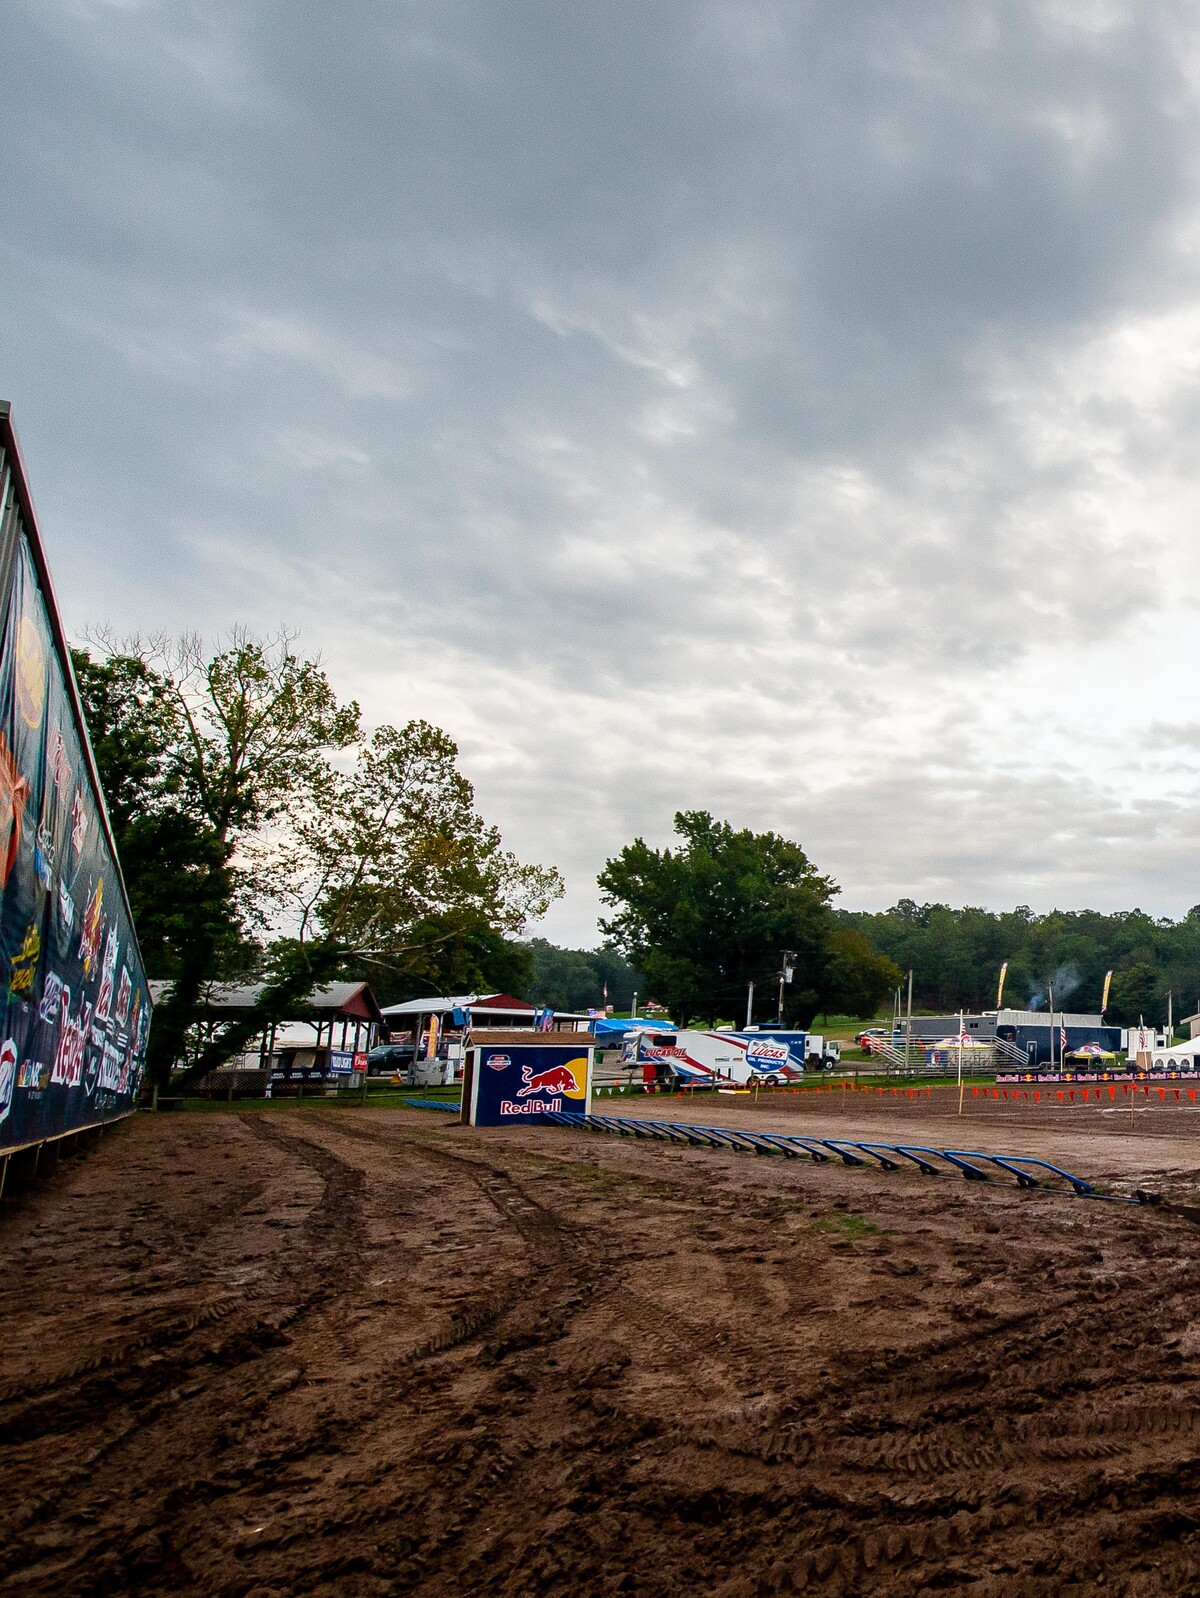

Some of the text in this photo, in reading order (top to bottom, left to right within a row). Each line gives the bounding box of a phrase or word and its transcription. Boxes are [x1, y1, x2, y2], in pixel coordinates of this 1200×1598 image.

[644, 1048, 688, 1057] LUCAS OIL
[751, 1047, 786, 1059] LUCAS
[757, 1058, 784, 1066] PRODUCTS
[500, 1098, 562, 1115] Red Bull
